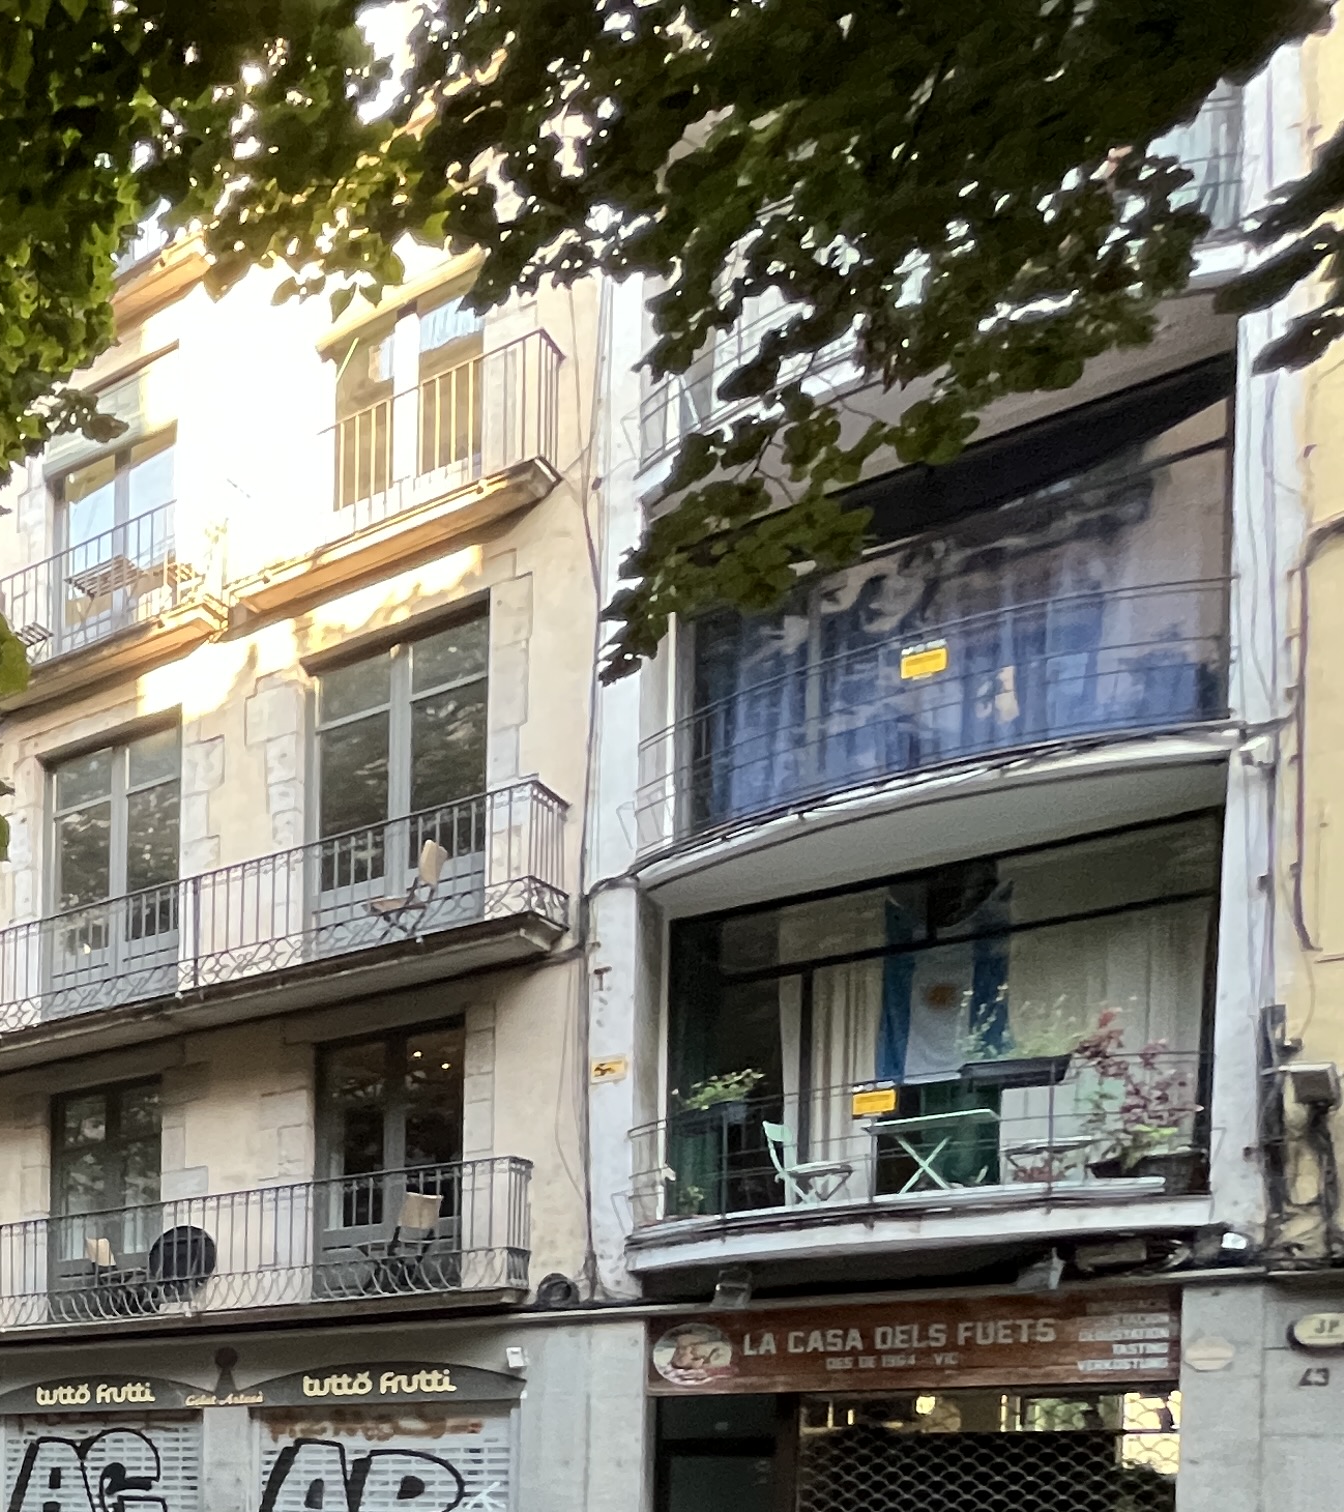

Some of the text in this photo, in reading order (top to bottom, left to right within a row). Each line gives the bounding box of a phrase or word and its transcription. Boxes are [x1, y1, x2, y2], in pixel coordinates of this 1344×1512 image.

[743, 1332, 777, 1356] LA
[787, 1328, 863, 1354] CASA
[874, 1323, 947, 1350] DELS
[957, 1318, 1057, 1346] FUETS
